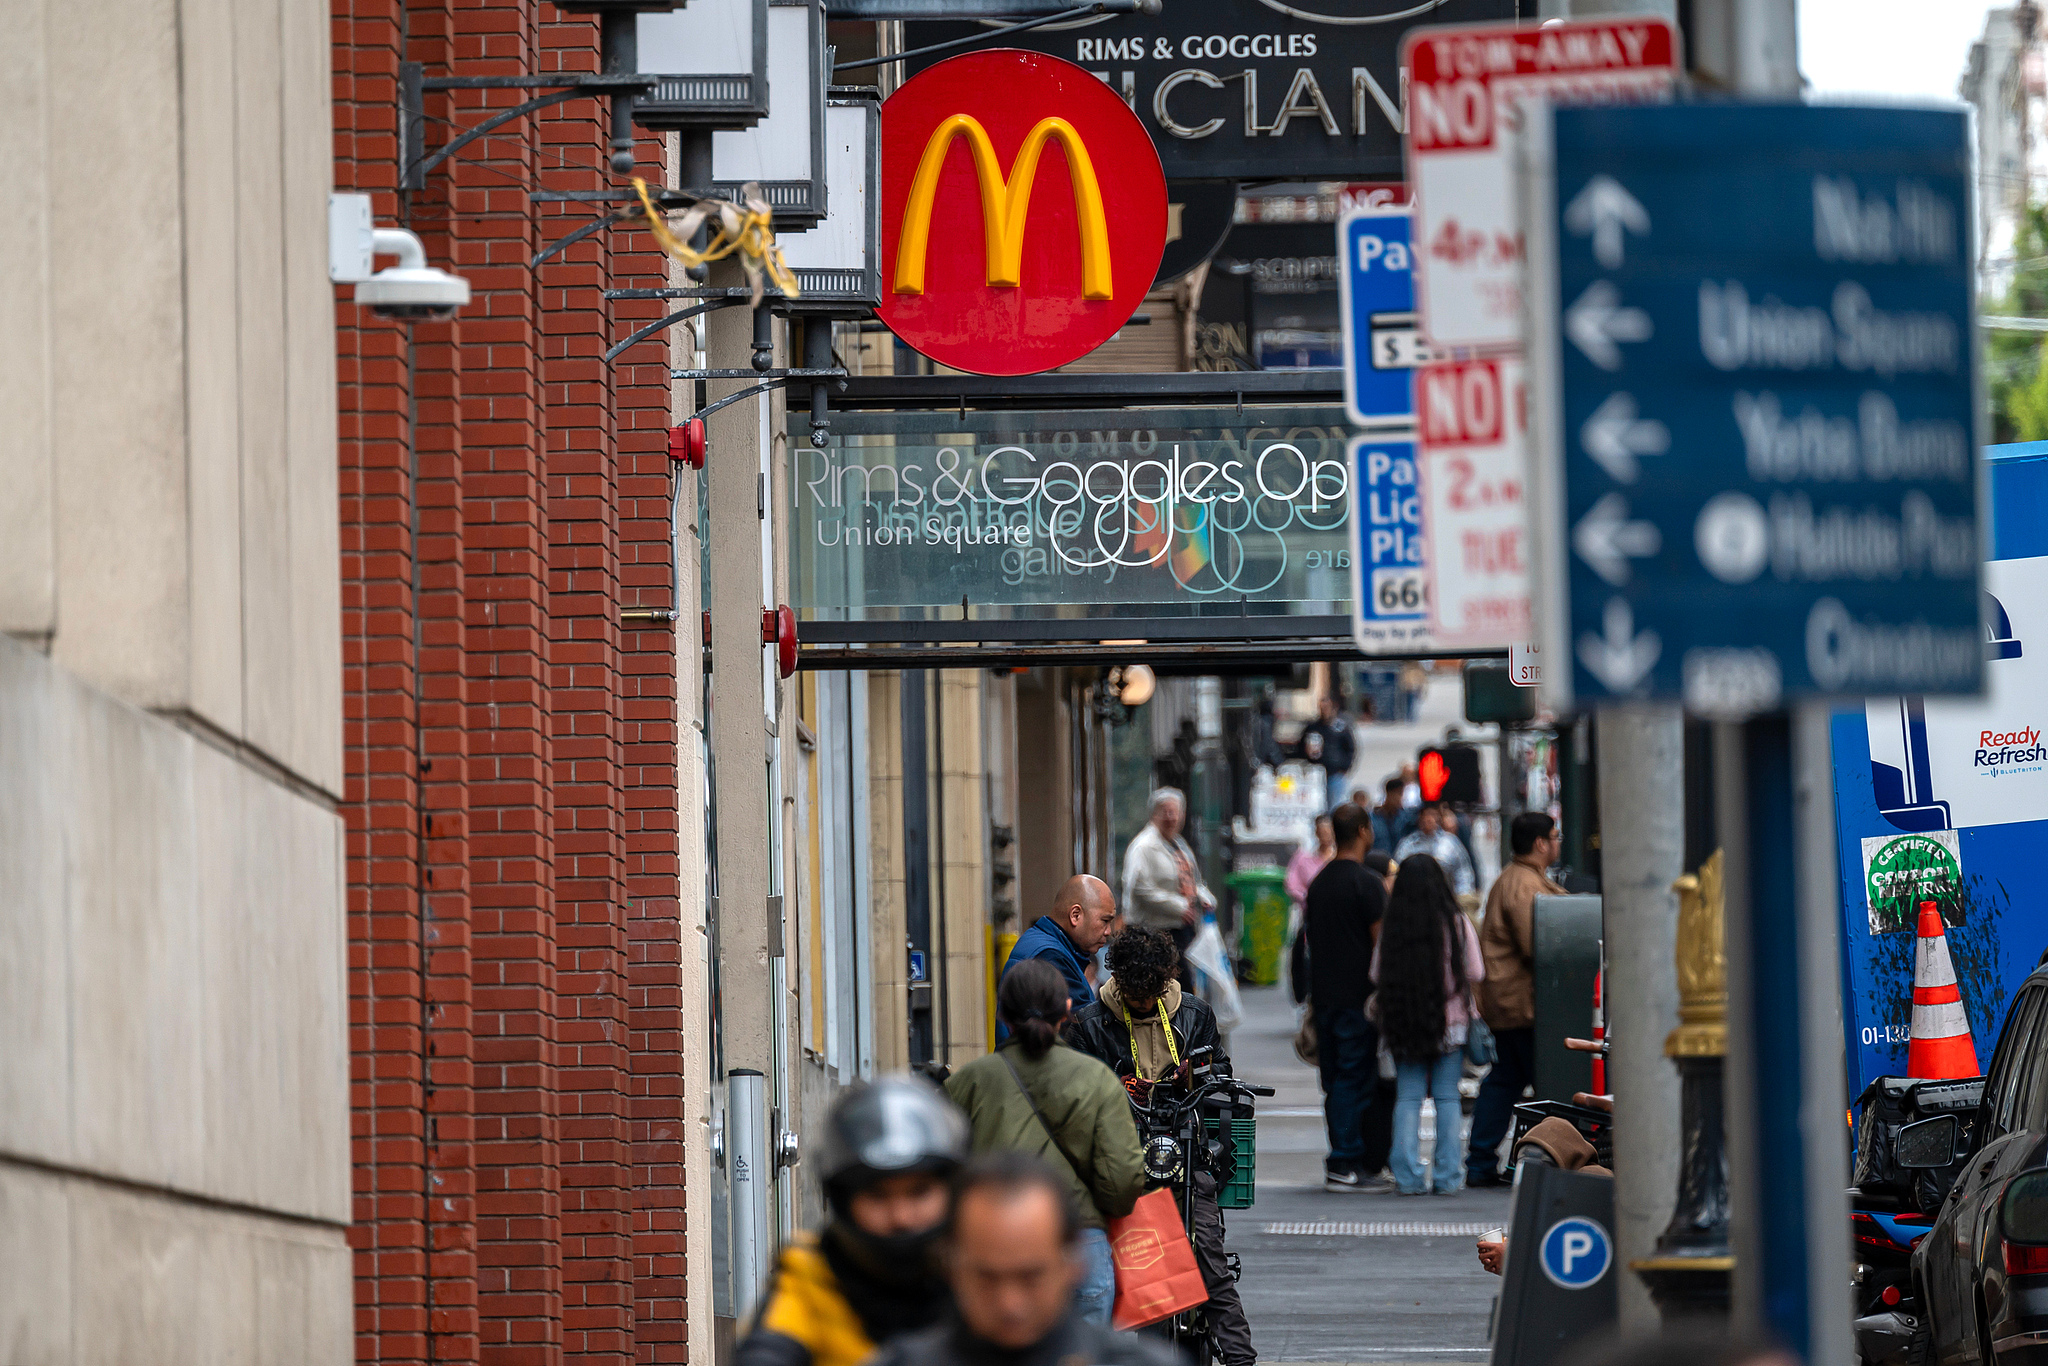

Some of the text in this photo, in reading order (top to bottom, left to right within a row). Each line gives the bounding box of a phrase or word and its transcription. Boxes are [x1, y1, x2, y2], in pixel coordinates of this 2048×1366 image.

[1077, 33, 1317, 61] RIMS & GOGGLES
[1432, 28, 1650, 77] TOW-AWAY
[1414, 82, 1487, 145] NO
[1426, 366, 1494, 438] NO
[794, 449, 924, 507] Rims
[932, 447, 978, 506] &
[981, 444, 1245, 567] Goggles
[817, 518, 1031, 554] Union Square
[1000, 540, 1122, 585] gallery
[1974, 742, 2048, 767] Refresh
[1980, 725, 2041, 748] Ready
[1120, 1239, 1154, 1255] PROPER
